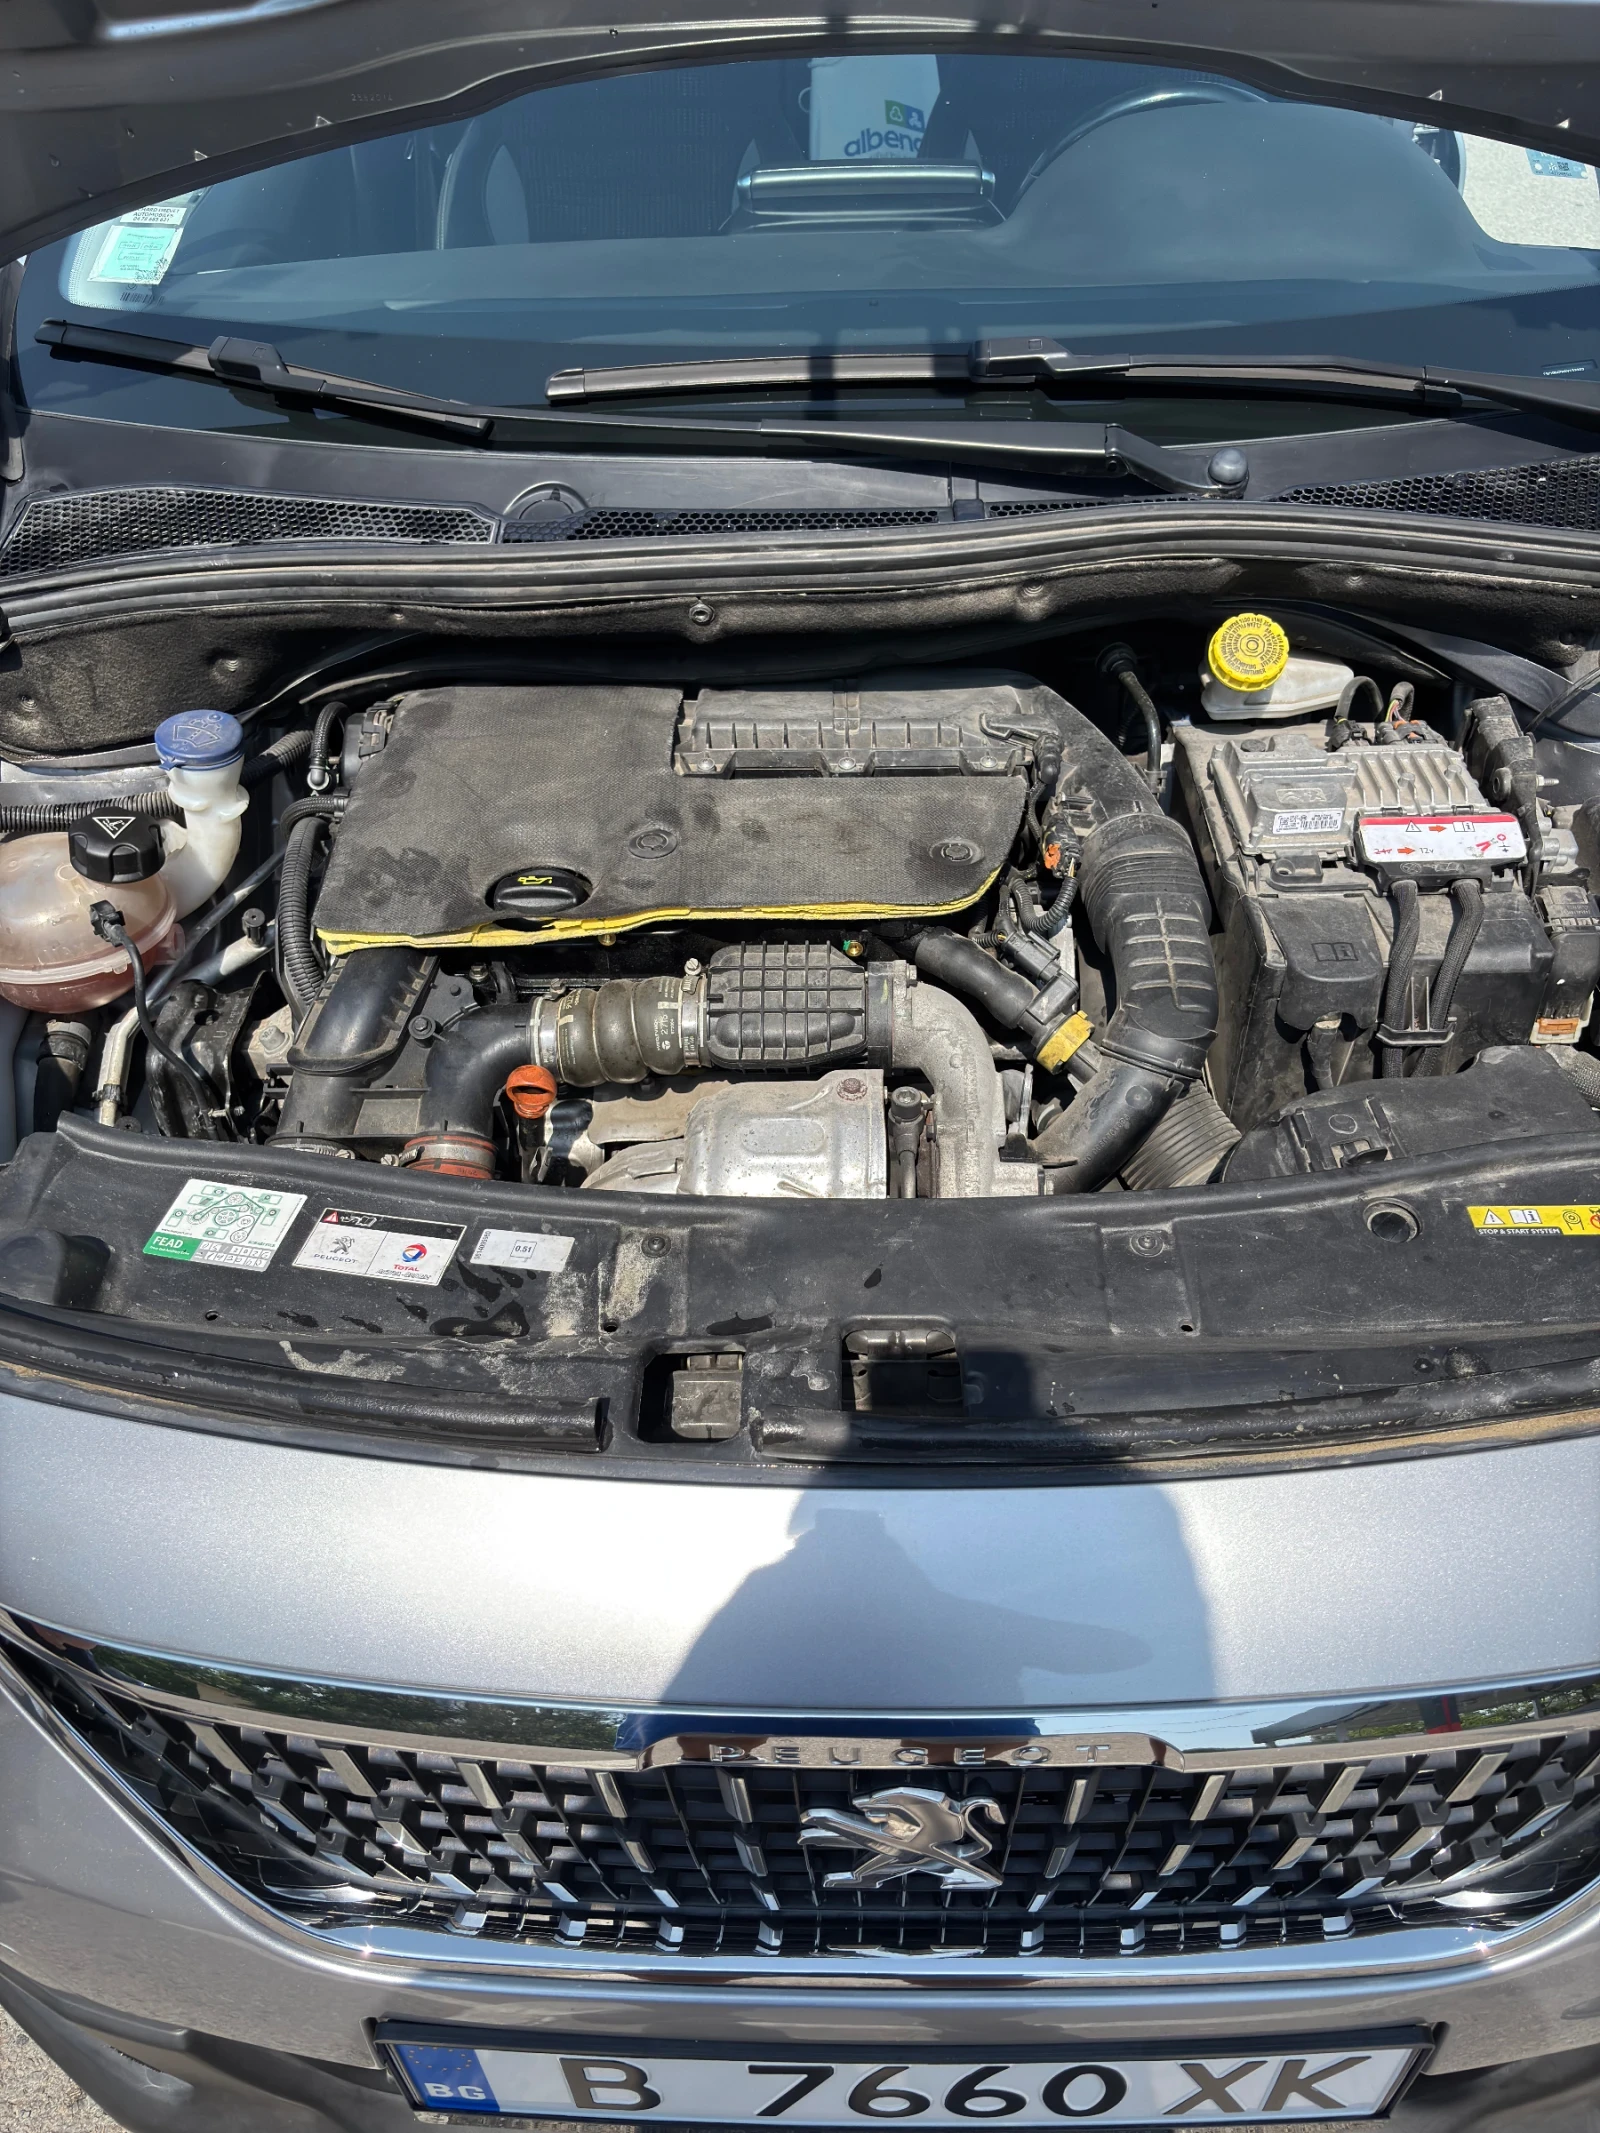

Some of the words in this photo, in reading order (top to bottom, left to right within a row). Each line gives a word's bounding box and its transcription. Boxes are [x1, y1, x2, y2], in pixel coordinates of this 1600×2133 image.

[152, 1236, 184, 1249] FEAD
[515, 1245, 532, 1253] 0.51
[313, 1253, 358, 1264] PEUGEOT
[393, 1264, 420, 1272] TOTAL
[709, 1744, 1111, 1766] PEUGEOT
[424, 2082, 486, 2101] BG
[560, 2057, 661, 2111] B
[748, 2063, 1127, 2118] 7660
[1162, 2055, 1372, 2115] XK
